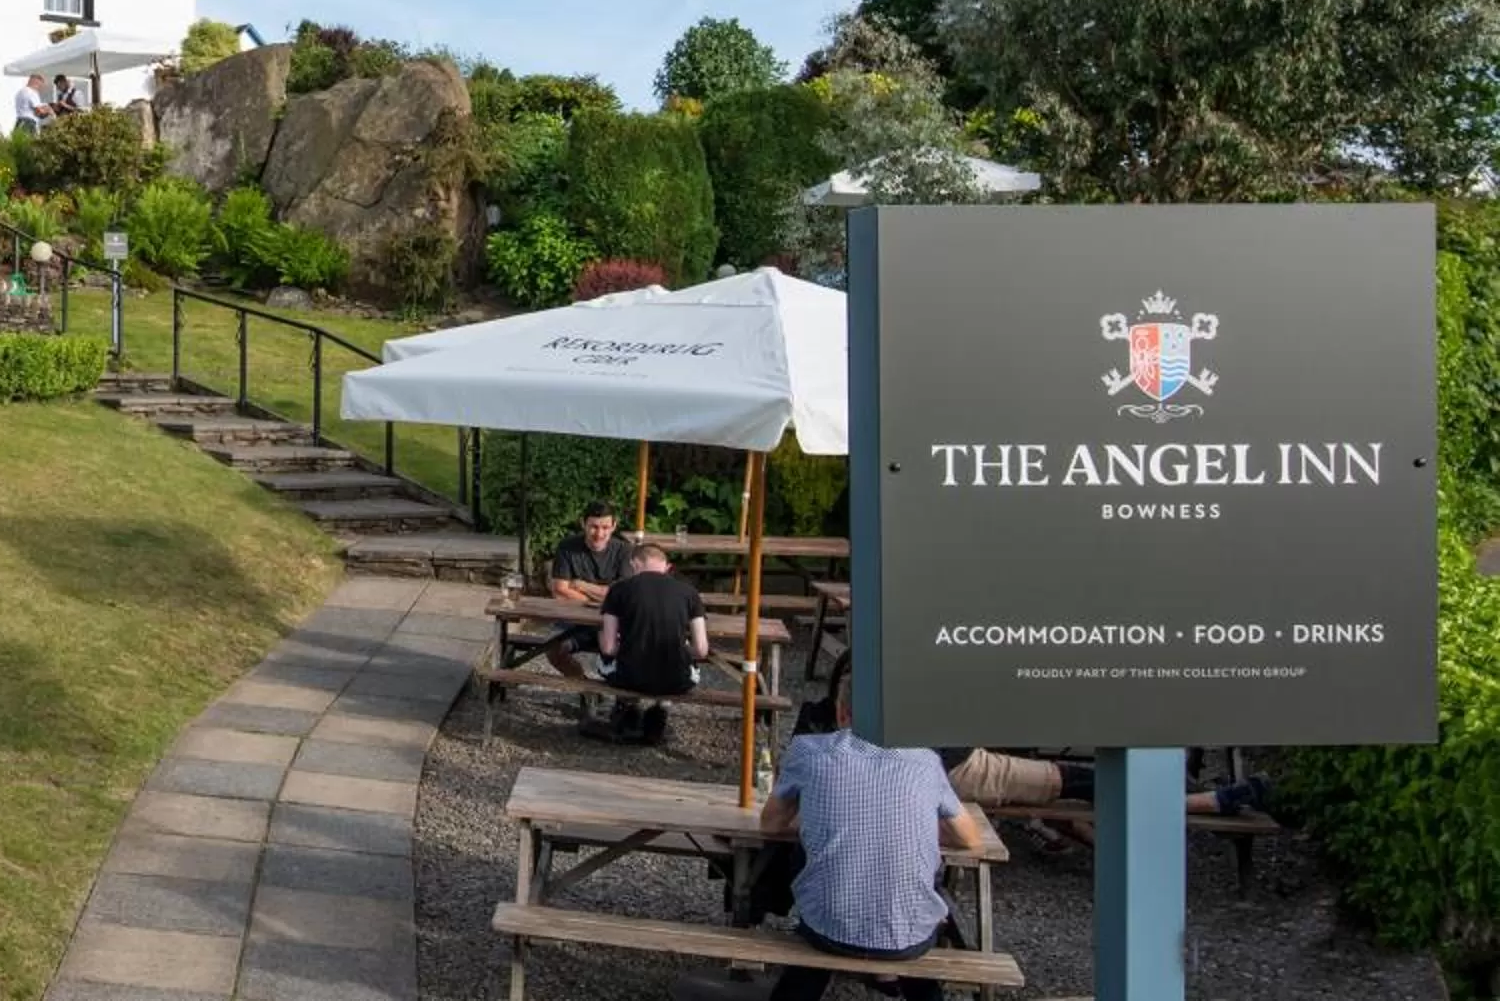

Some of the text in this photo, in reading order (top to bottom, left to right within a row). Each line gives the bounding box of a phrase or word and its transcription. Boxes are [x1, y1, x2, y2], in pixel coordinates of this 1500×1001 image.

[931, 442, 1382, 486] THE ANGEL INN
[1102, 503, 1221, 520] BOWNESS
[936, 623, 1385, 645] ACCOMMODATION FOOD DRINKS
[1017, 667, 1306, 679] PROUDLY PART OF THE INN COLLECTION GROUP
